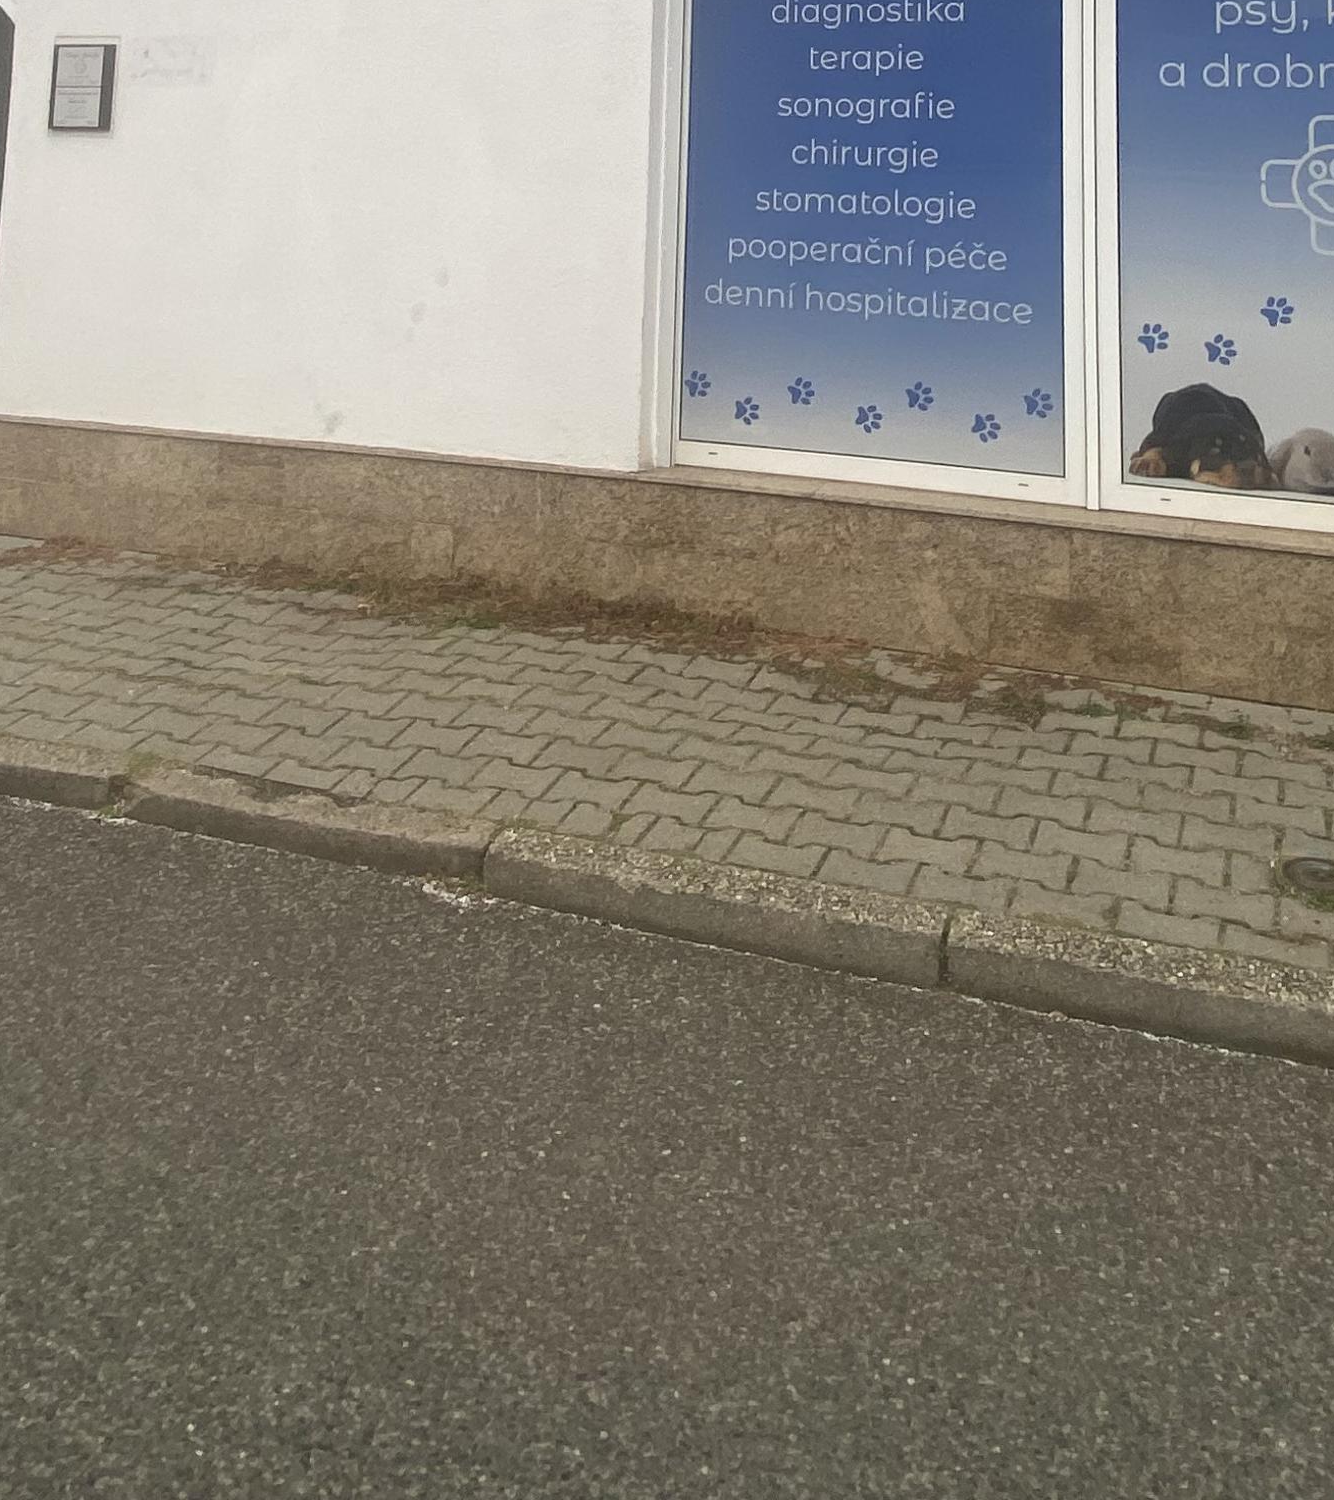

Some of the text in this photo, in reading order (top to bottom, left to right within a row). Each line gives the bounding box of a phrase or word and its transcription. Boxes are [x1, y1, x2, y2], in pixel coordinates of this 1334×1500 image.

[1215, 0, 1309, 34] psy,
[809, 43, 924, 77] terapie
[1158, 60, 1186, 88] a
[777, 92, 955, 124] sonografie
[791, 139, 939, 173] chirurgie
[756, 189, 976, 224] stomatologie
[728, 236, 1008, 274] pooperační péče
[705, 278, 1033, 325] denní hospitalizace
